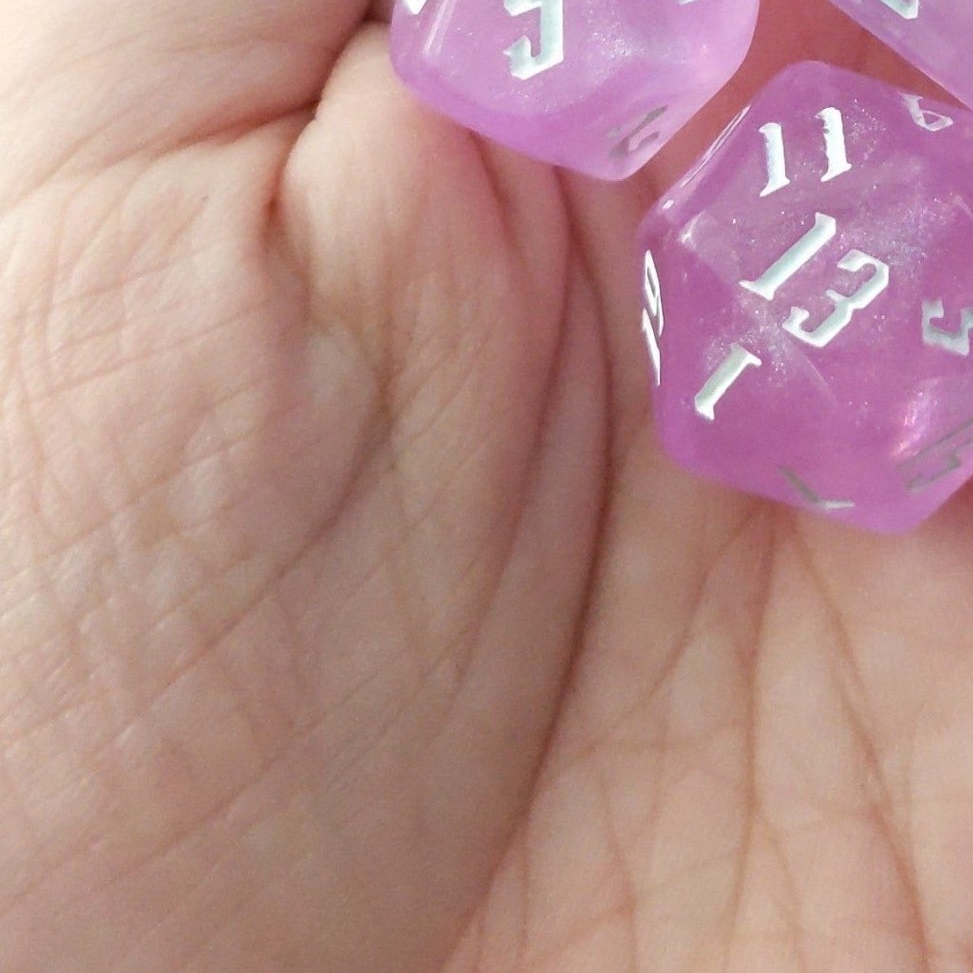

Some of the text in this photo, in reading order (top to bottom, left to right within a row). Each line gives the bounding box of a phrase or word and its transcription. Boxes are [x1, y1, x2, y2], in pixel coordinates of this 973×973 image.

[758, 106, 853, 197] 11
[738, 211, 890, 348] 13
[693, 341, 763, 421] 1
